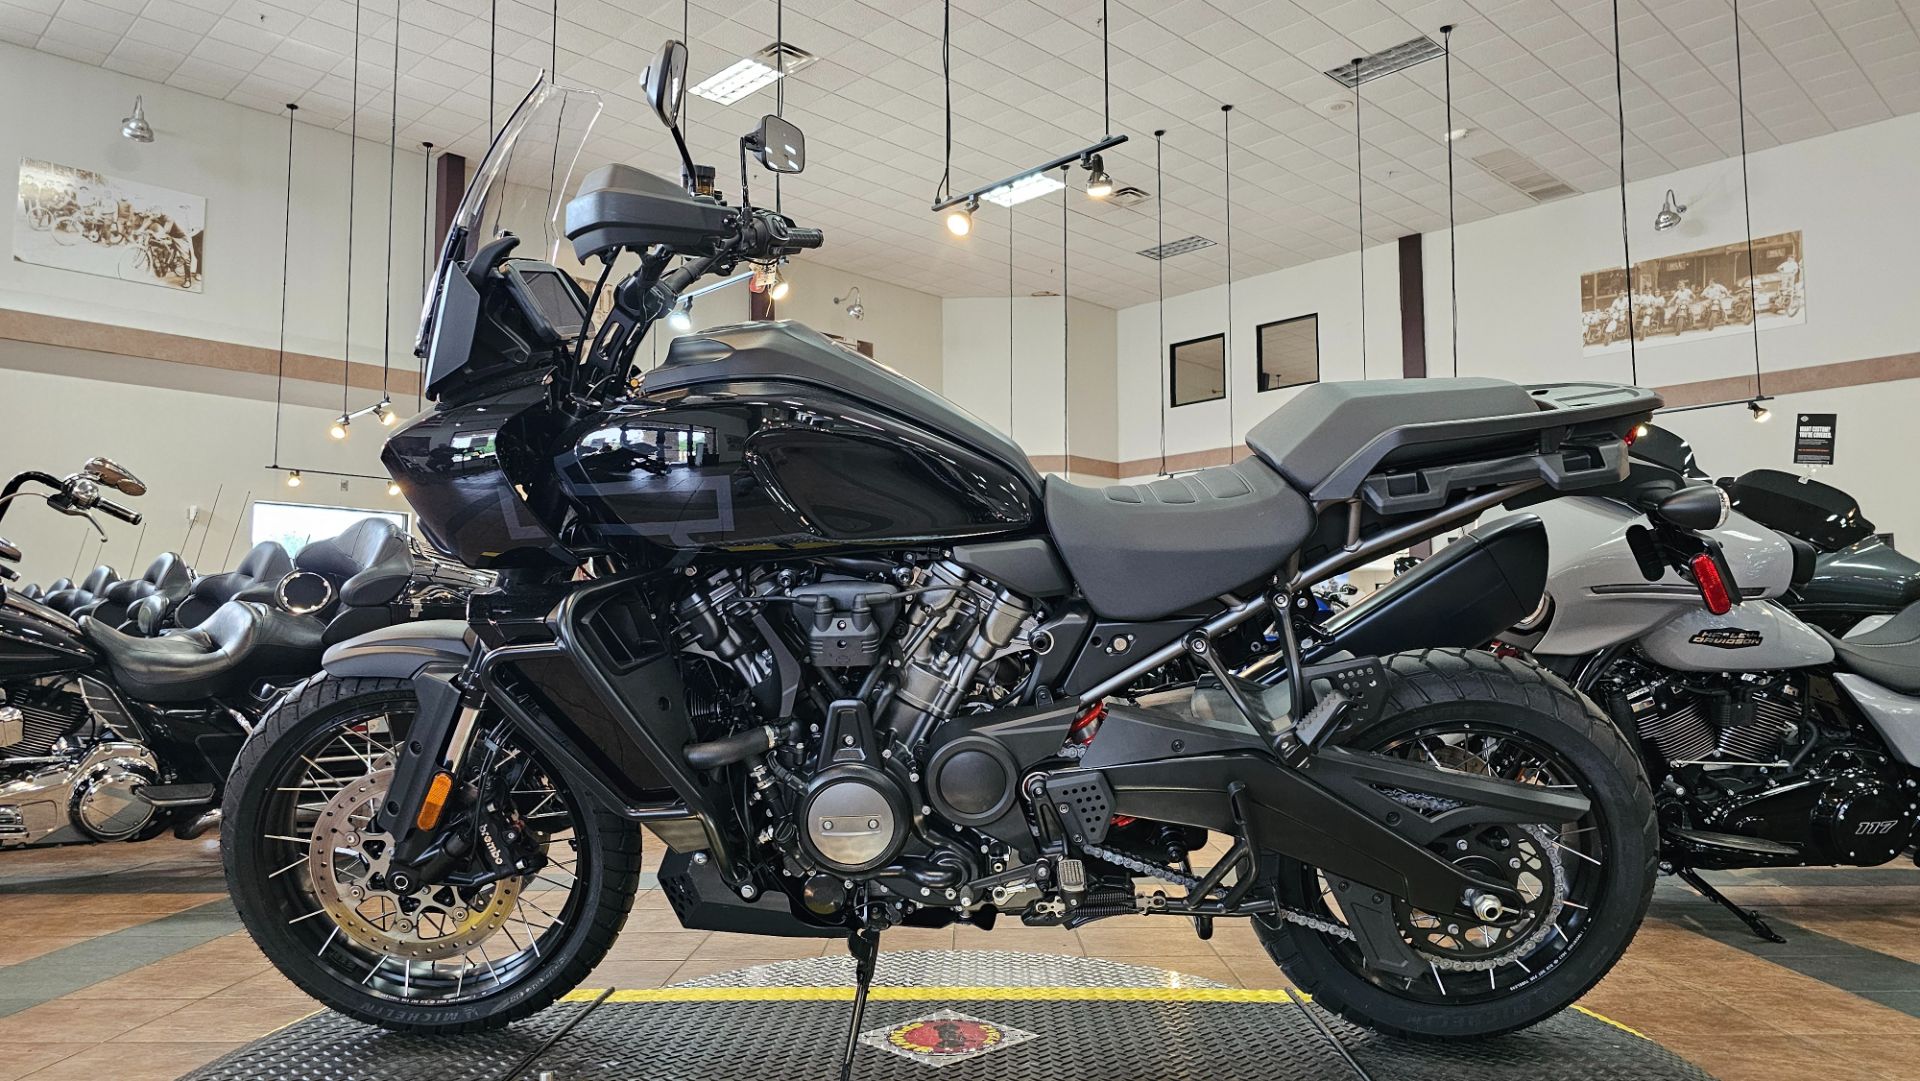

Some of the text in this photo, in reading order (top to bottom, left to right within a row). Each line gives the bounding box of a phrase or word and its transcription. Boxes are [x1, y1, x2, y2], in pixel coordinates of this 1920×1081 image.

[1693, 636, 1760, 645] DAVIDSON
[1855, 820, 1898, 834] 117
[479, 823, 503, 865] brembo
[360, 1002, 459, 1021] MICHELIN
